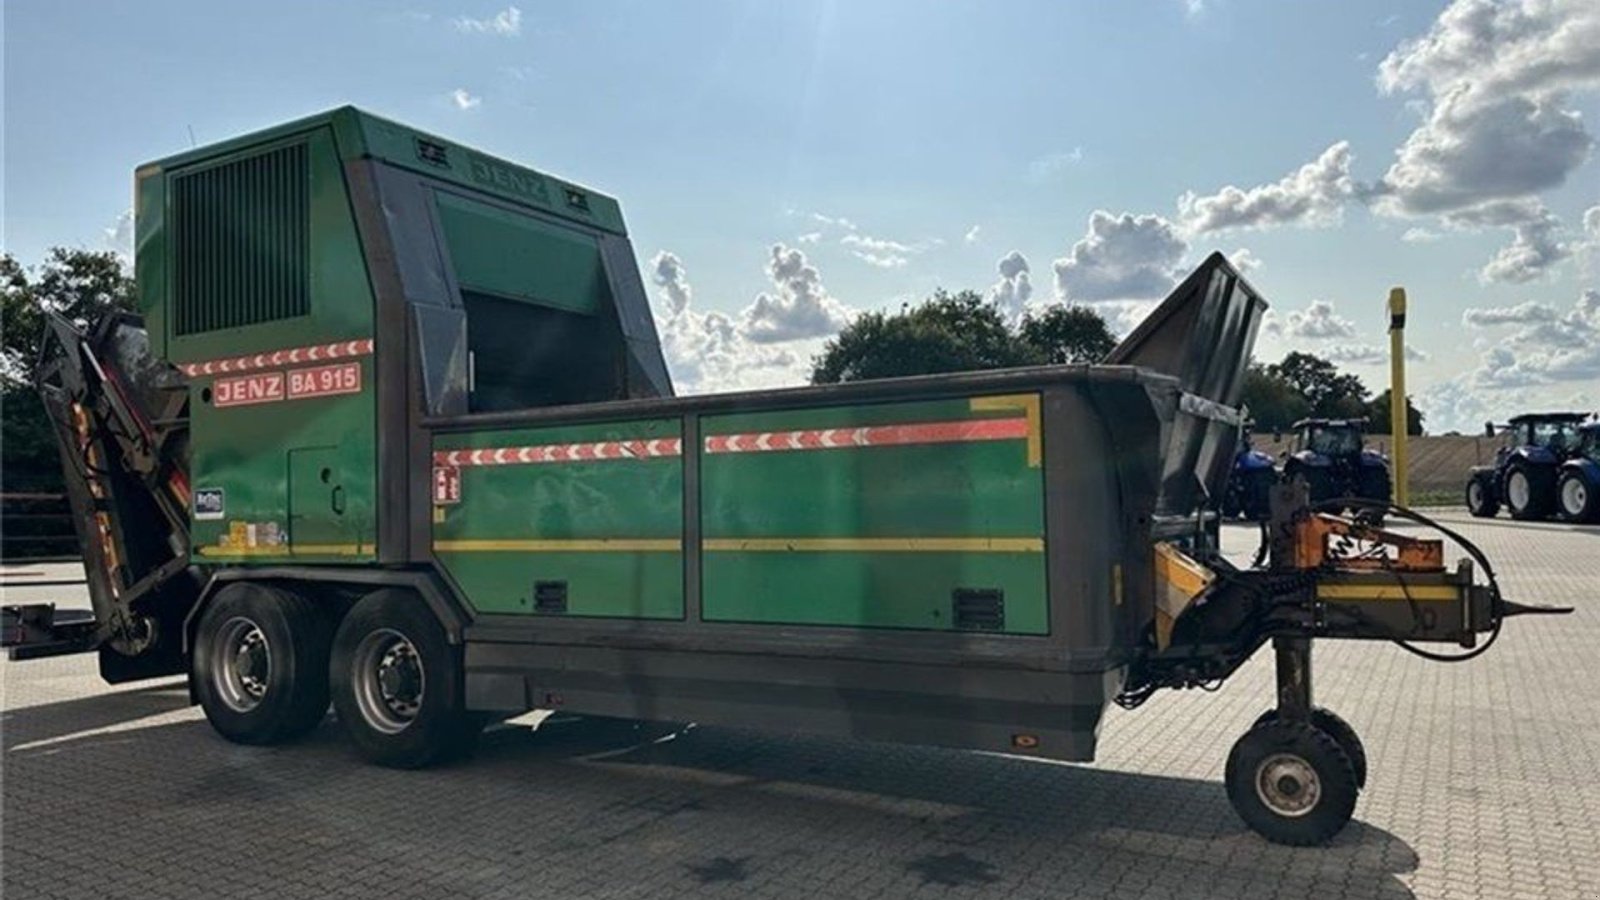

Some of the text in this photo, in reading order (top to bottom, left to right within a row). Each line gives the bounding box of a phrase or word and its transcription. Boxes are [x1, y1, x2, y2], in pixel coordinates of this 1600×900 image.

[472, 161, 545, 195] JENZ
[217, 377, 280, 402] JENZ
[291, 369, 355, 392] BA 915
